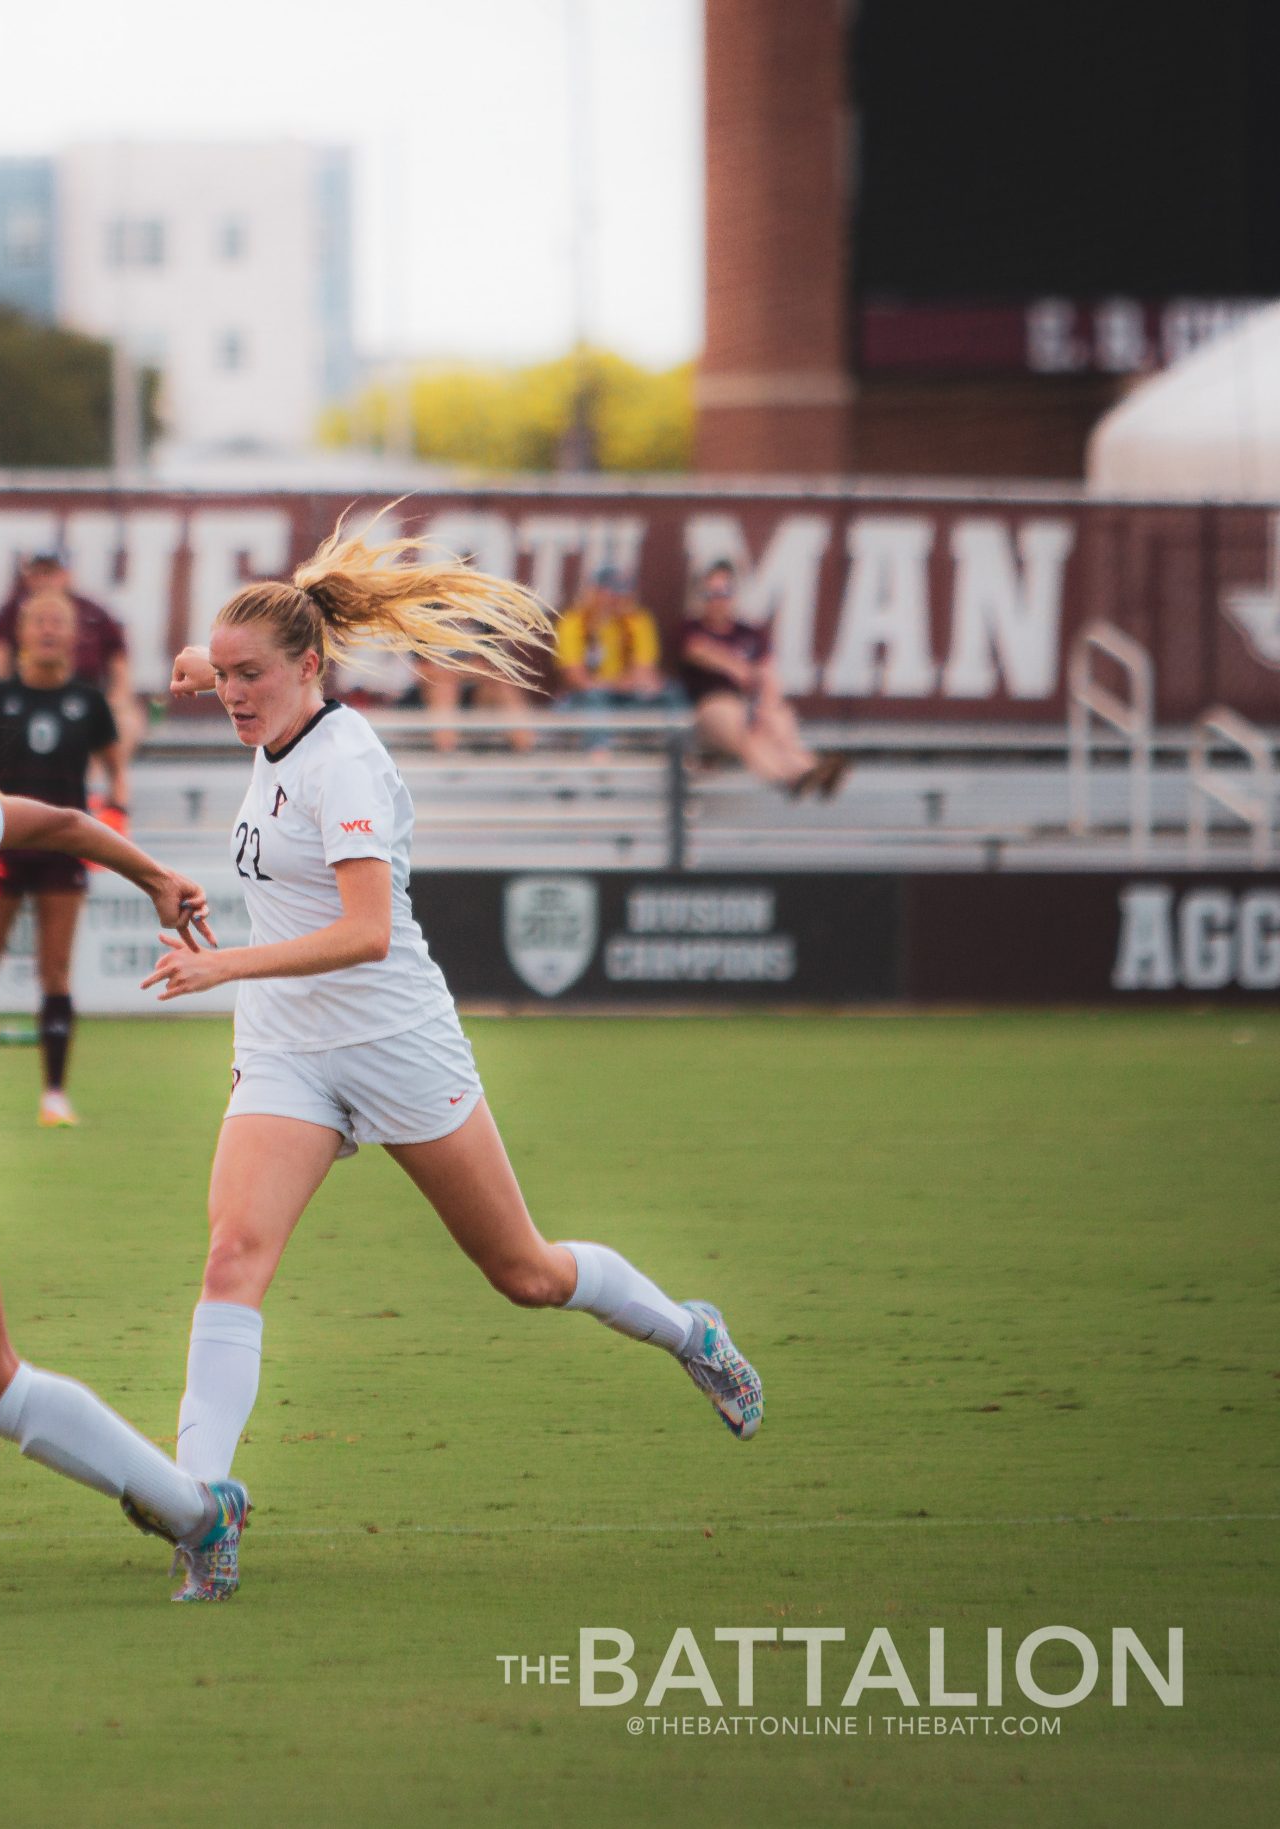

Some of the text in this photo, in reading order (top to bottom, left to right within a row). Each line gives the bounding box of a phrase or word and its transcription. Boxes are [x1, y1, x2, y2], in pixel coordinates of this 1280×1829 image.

[682, 514, 1076, 697] MAN
[235, 821, 274, 881] 22
[340, 820, 373, 833] WCC
[605, 938, 796, 981] CHAMPIONS
